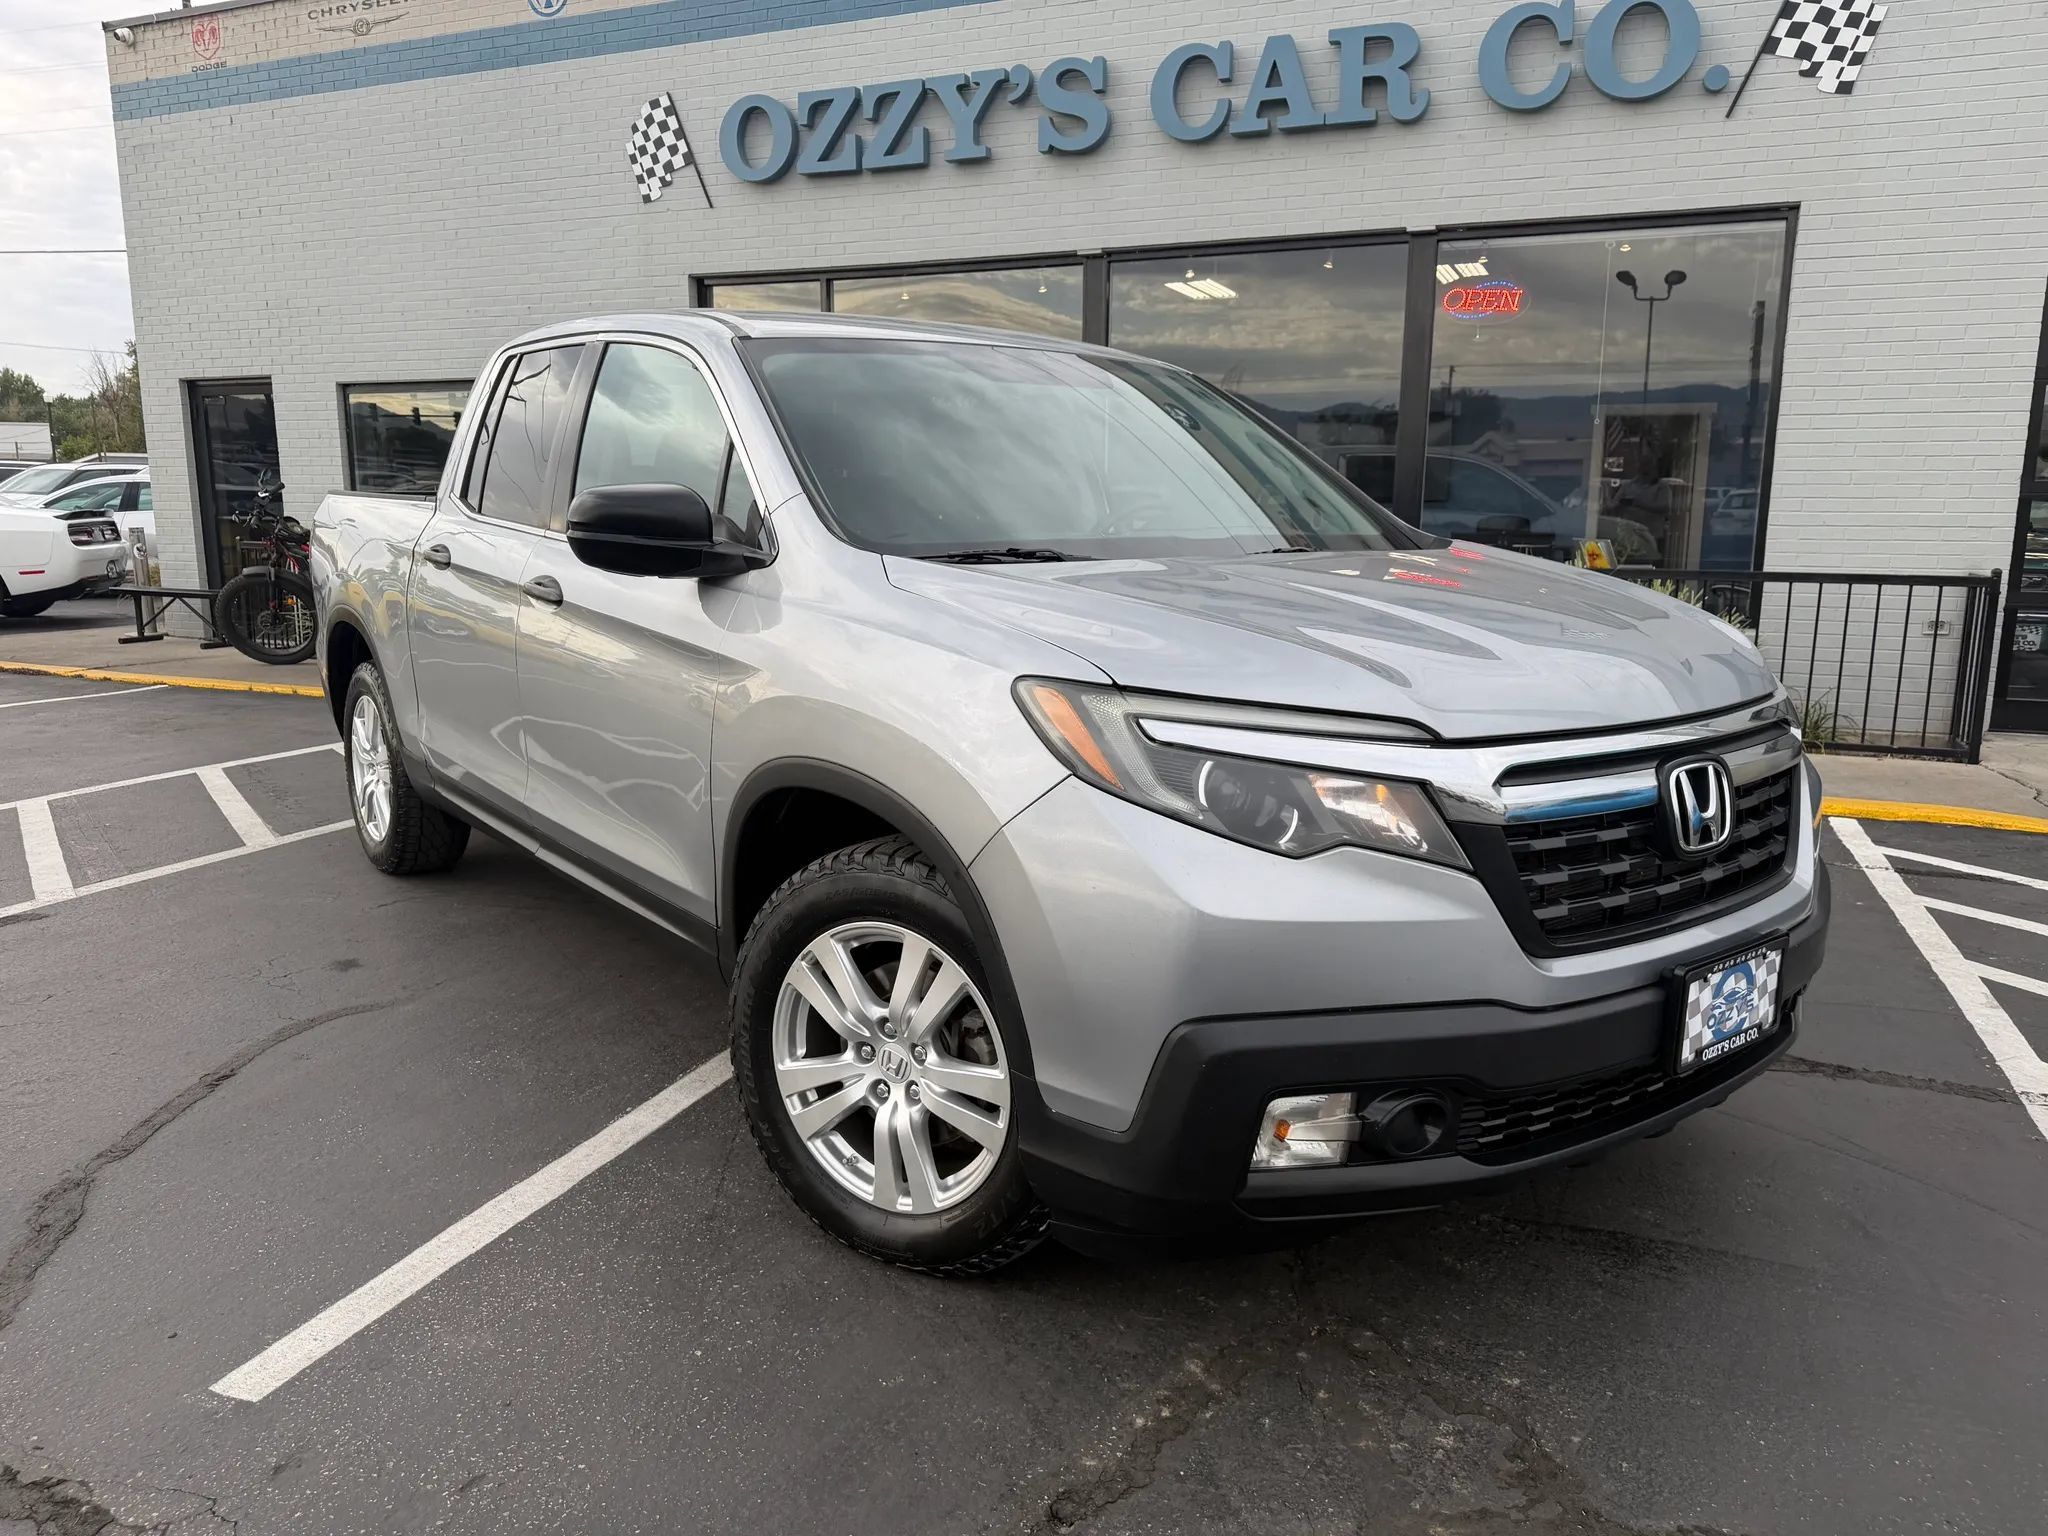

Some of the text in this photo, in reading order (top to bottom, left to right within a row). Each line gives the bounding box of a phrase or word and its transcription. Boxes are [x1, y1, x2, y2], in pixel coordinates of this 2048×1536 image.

[308, 0, 416, 20] CHRYSL
[191, 61, 227, 72] DODGE
[719, 0, 1730, 183] OZZY'S CAR CO.
[1443, 287, 1523, 312] OPEN
[1702, 1027, 1759, 1061] OZZY'S CAR CO.
